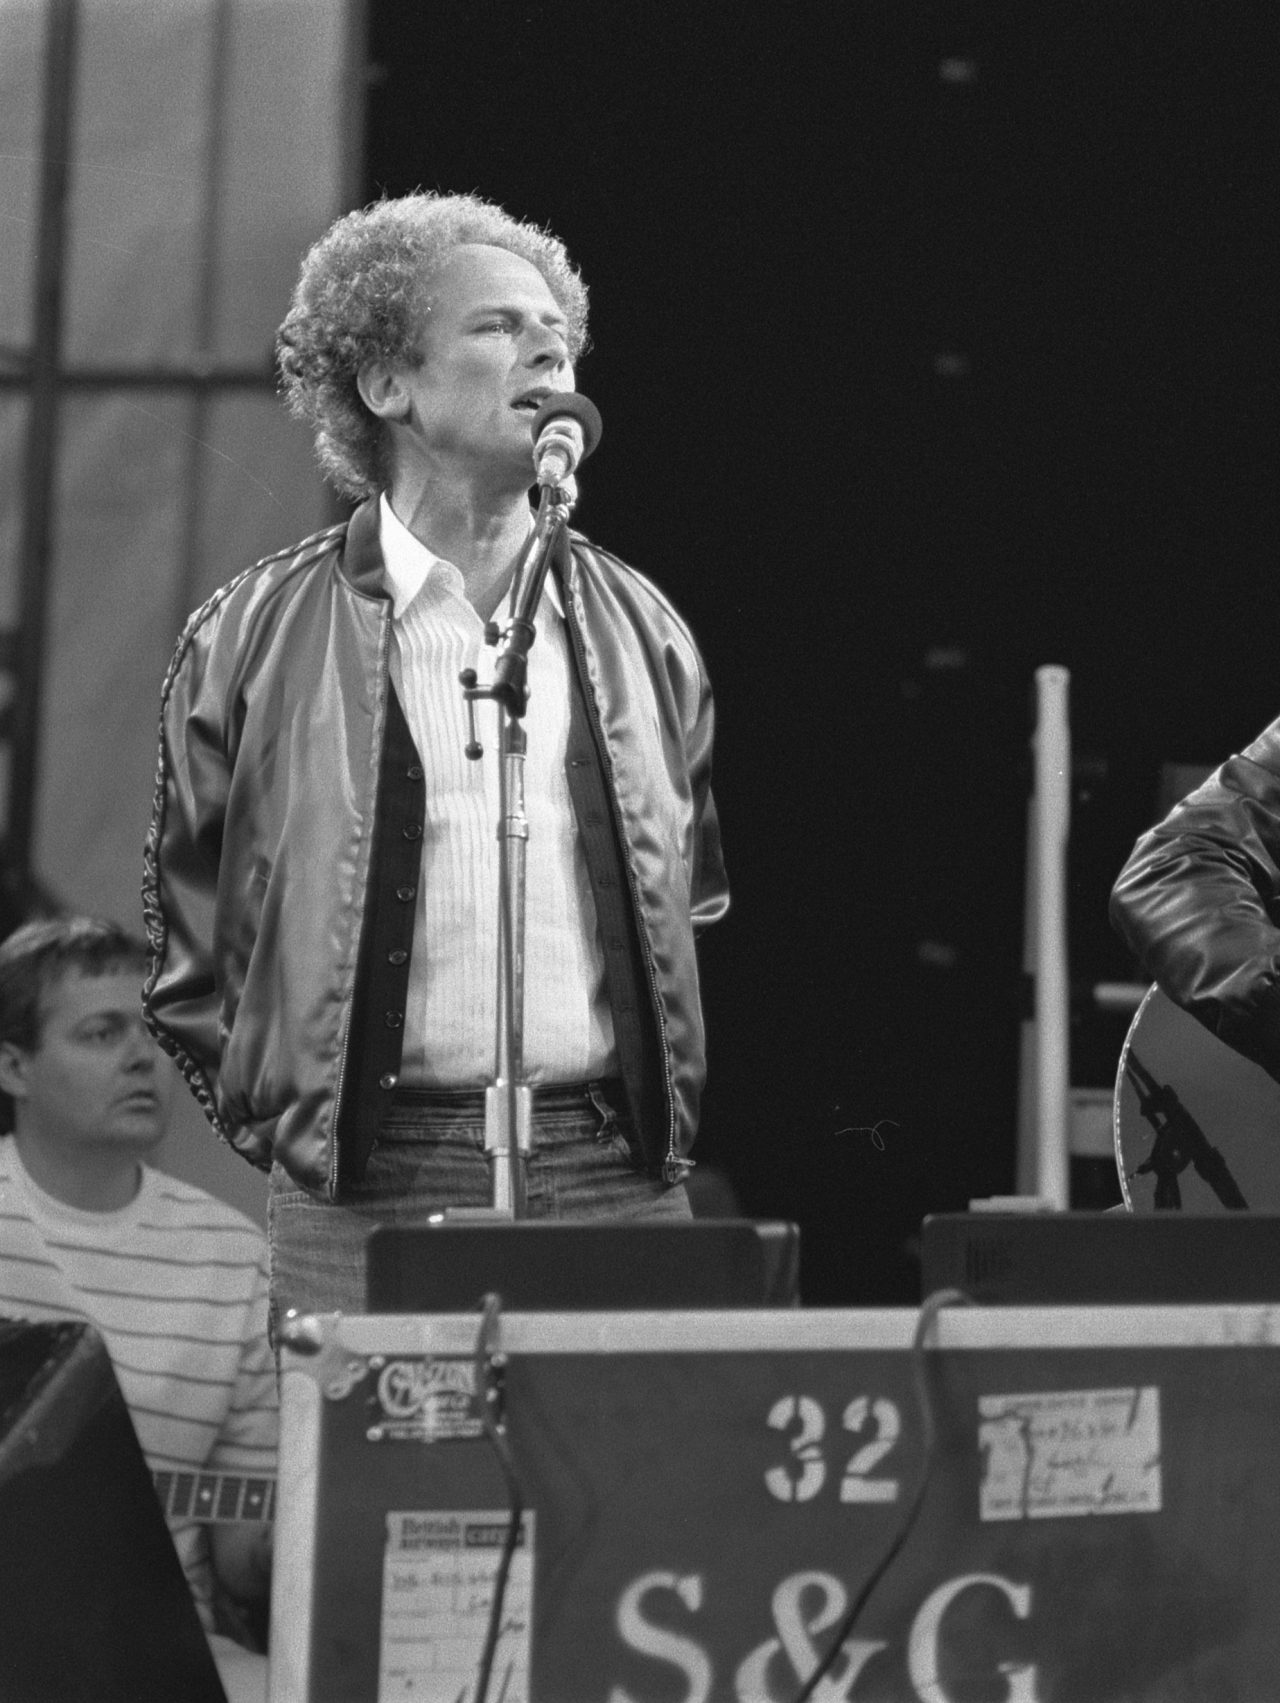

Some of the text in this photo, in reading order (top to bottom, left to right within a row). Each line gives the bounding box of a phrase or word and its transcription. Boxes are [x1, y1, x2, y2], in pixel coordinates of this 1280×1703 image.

[764, 1395, 901, 1503] 32
[401, 1516, 459, 1535] British
[611, 1570, 1037, 1703] S&G
